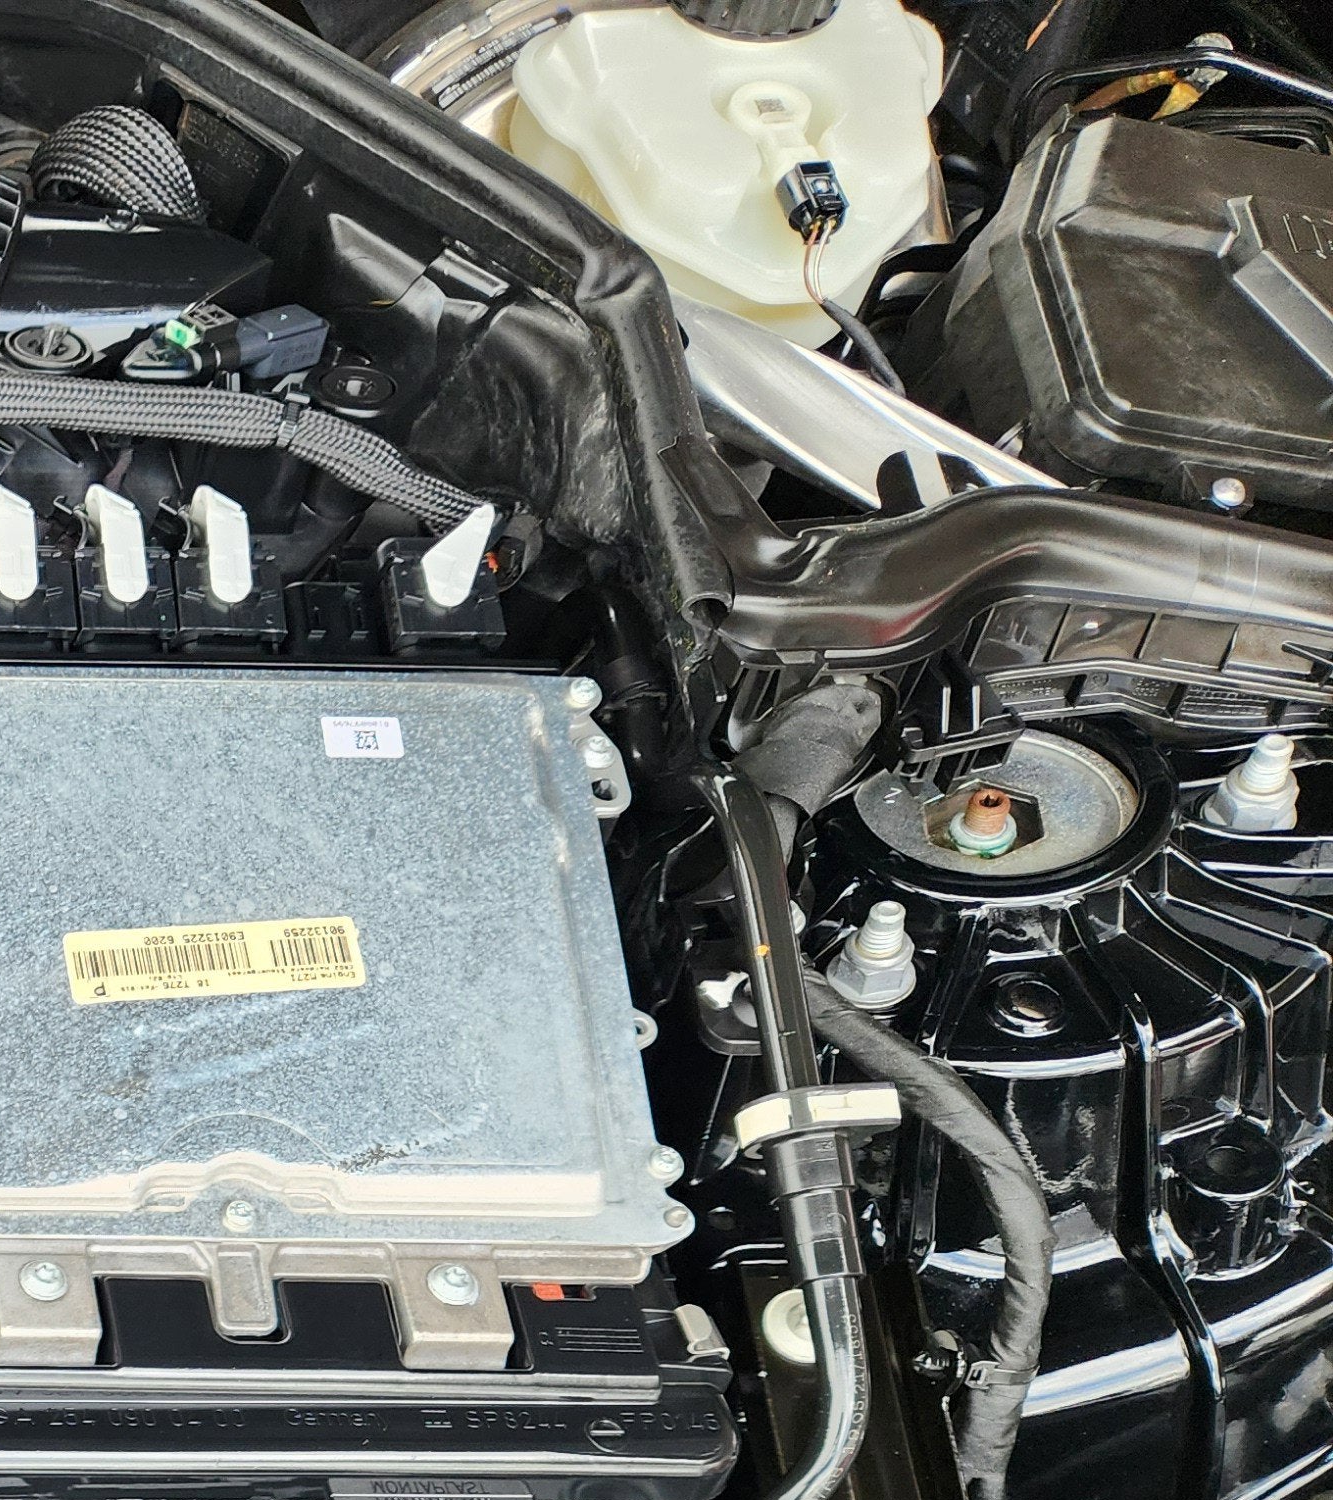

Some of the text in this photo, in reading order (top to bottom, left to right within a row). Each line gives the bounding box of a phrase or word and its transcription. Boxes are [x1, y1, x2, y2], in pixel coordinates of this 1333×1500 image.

[283, 924, 346, 938] 90132259
[144, 934, 175, 946] 6200
[320, 970, 356, 982] Engine
[108, 1407, 157, 1427] 090
[285, 1408, 390, 1432] Germany
